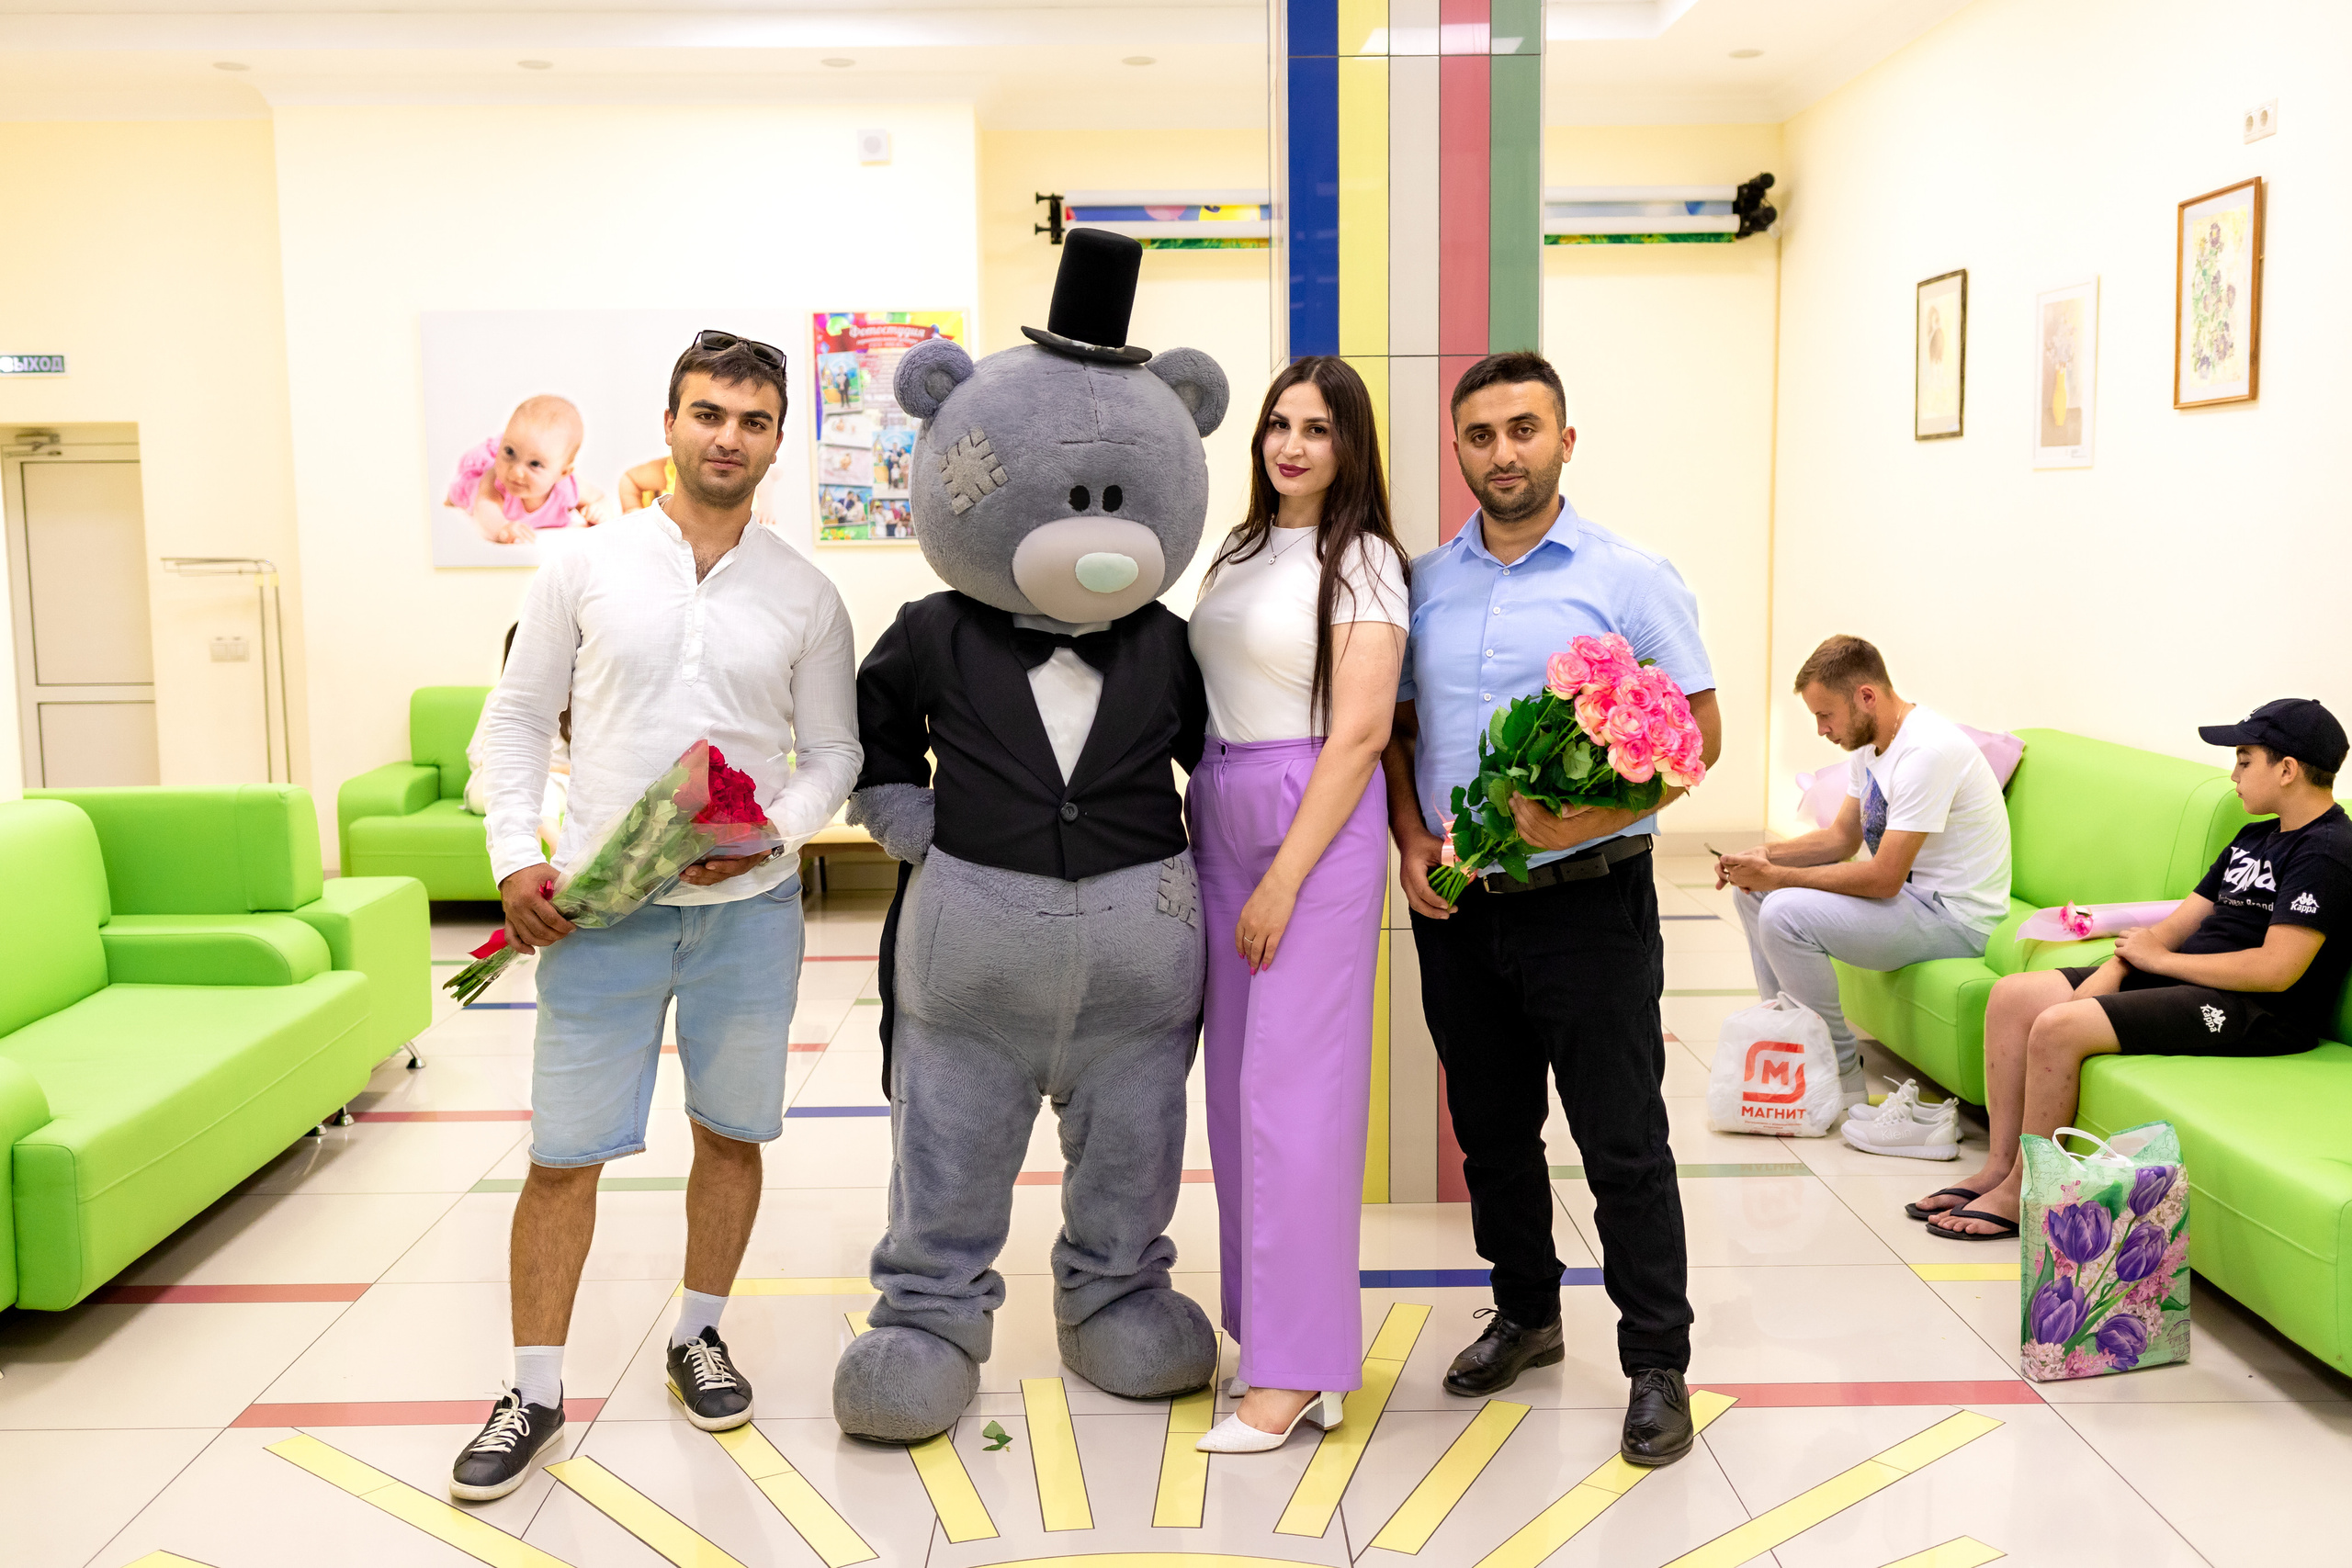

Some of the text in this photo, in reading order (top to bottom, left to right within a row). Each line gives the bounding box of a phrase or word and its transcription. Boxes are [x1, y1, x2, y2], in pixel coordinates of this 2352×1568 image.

[2290, 902, 2317, 914] Kappa
[2199, 1004, 2217, 1032] Kappa
[1741, 1106, 1806, 1120] МАГНИТ
[1881, 1129, 1912, 1141] Klein
